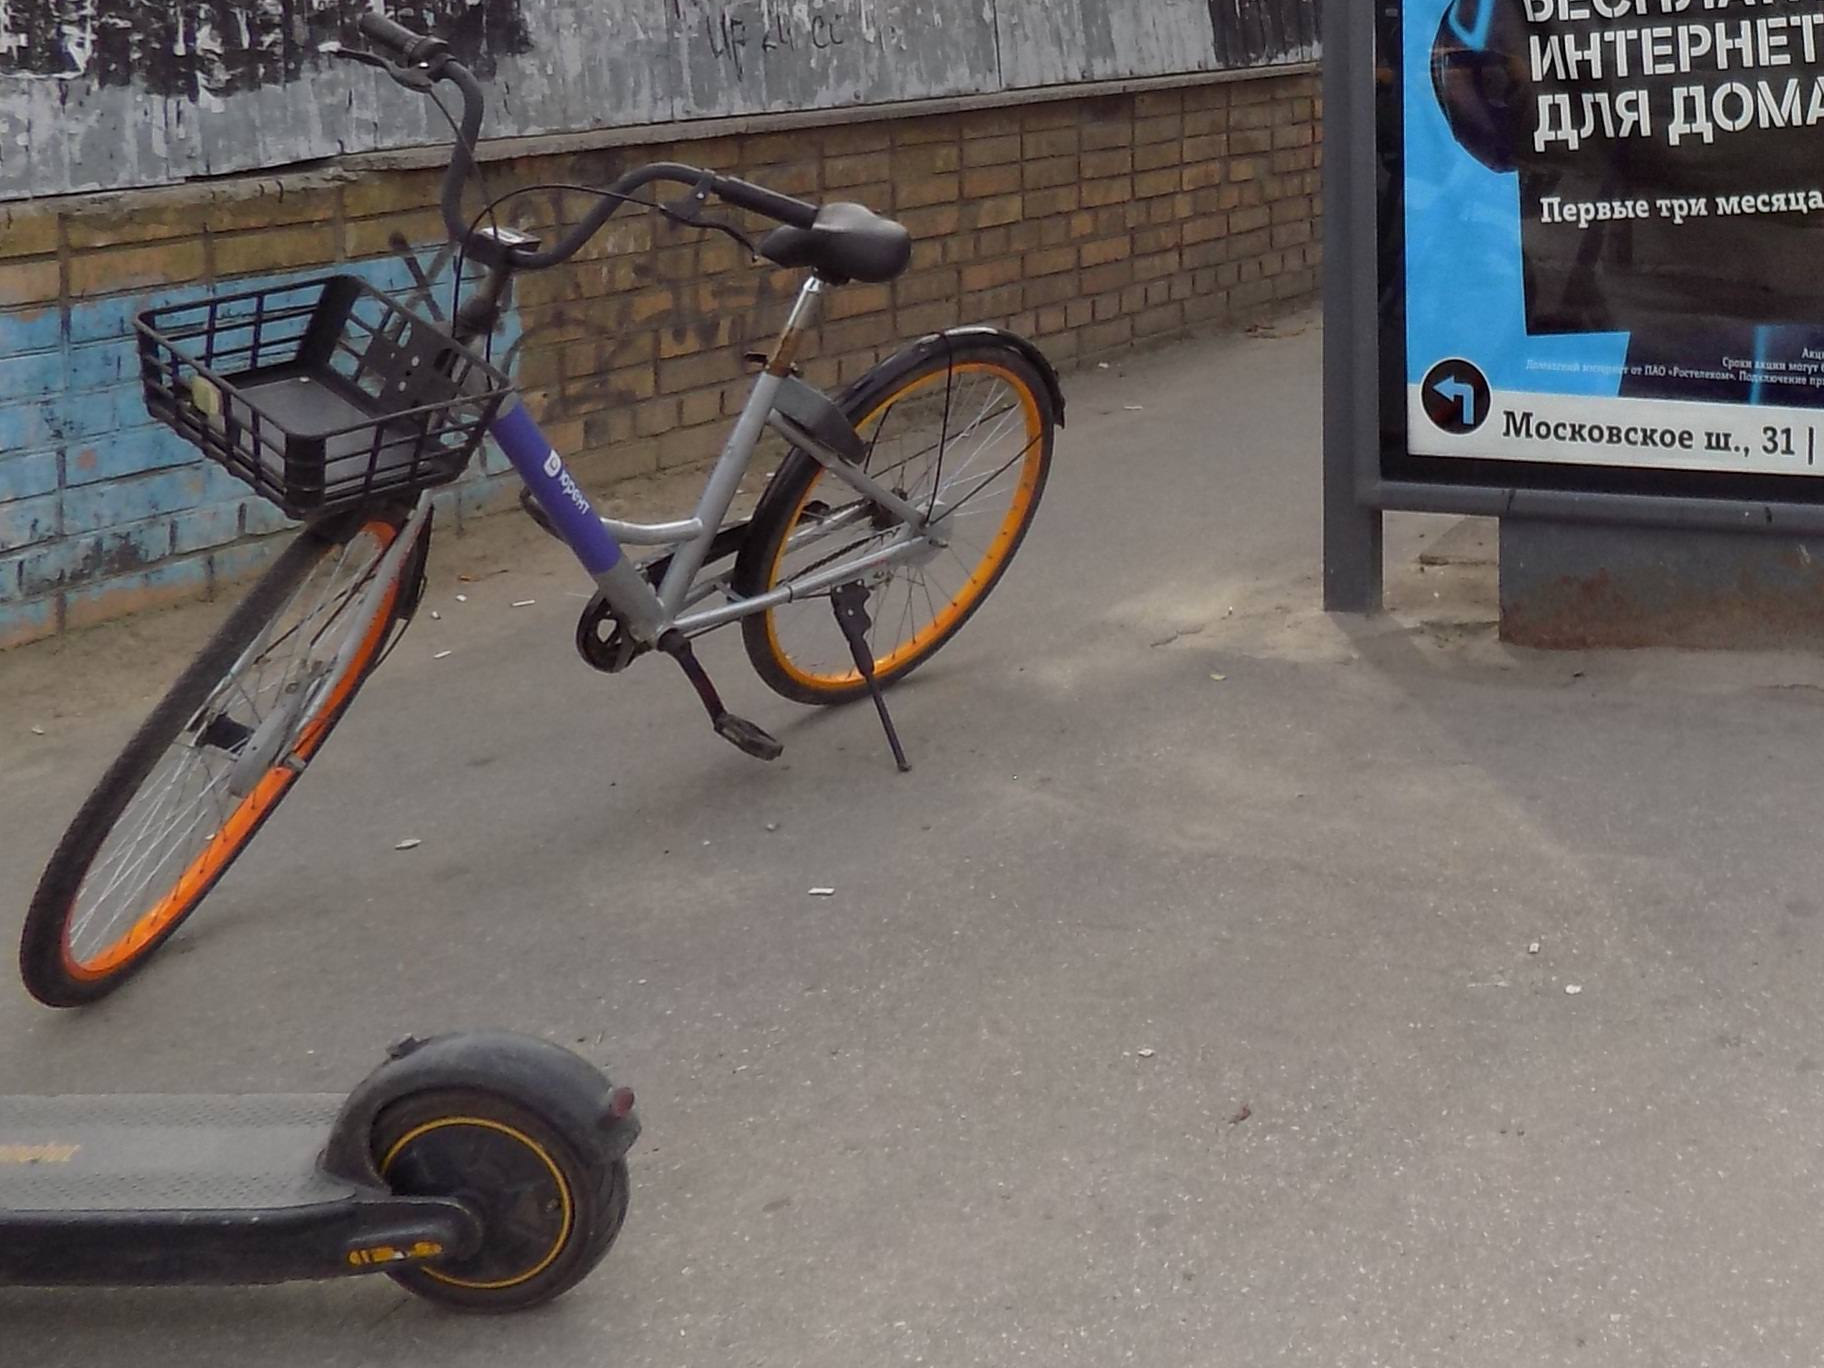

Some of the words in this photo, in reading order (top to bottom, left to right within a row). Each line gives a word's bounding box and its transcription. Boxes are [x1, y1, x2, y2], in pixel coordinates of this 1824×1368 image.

[1529, 13, 1824, 82] ИНТЕРНЕТ
[1533, 89, 1652, 153] ДЛЯ
[1540, 195, 1650, 229] Первые
[1655, 196, 1708, 225] три
[1630, 367, 1643, 376] от
[1645, 365, 1666, 378] ПАО
[1721, 356, 1753, 371] Сроки
[1788, 362, 1819, 376] могут
[1501, 410, 1694, 451] Московское
[1703, 428, 1751, 459] ш.,
[1760, 425, 1795, 457] 31
